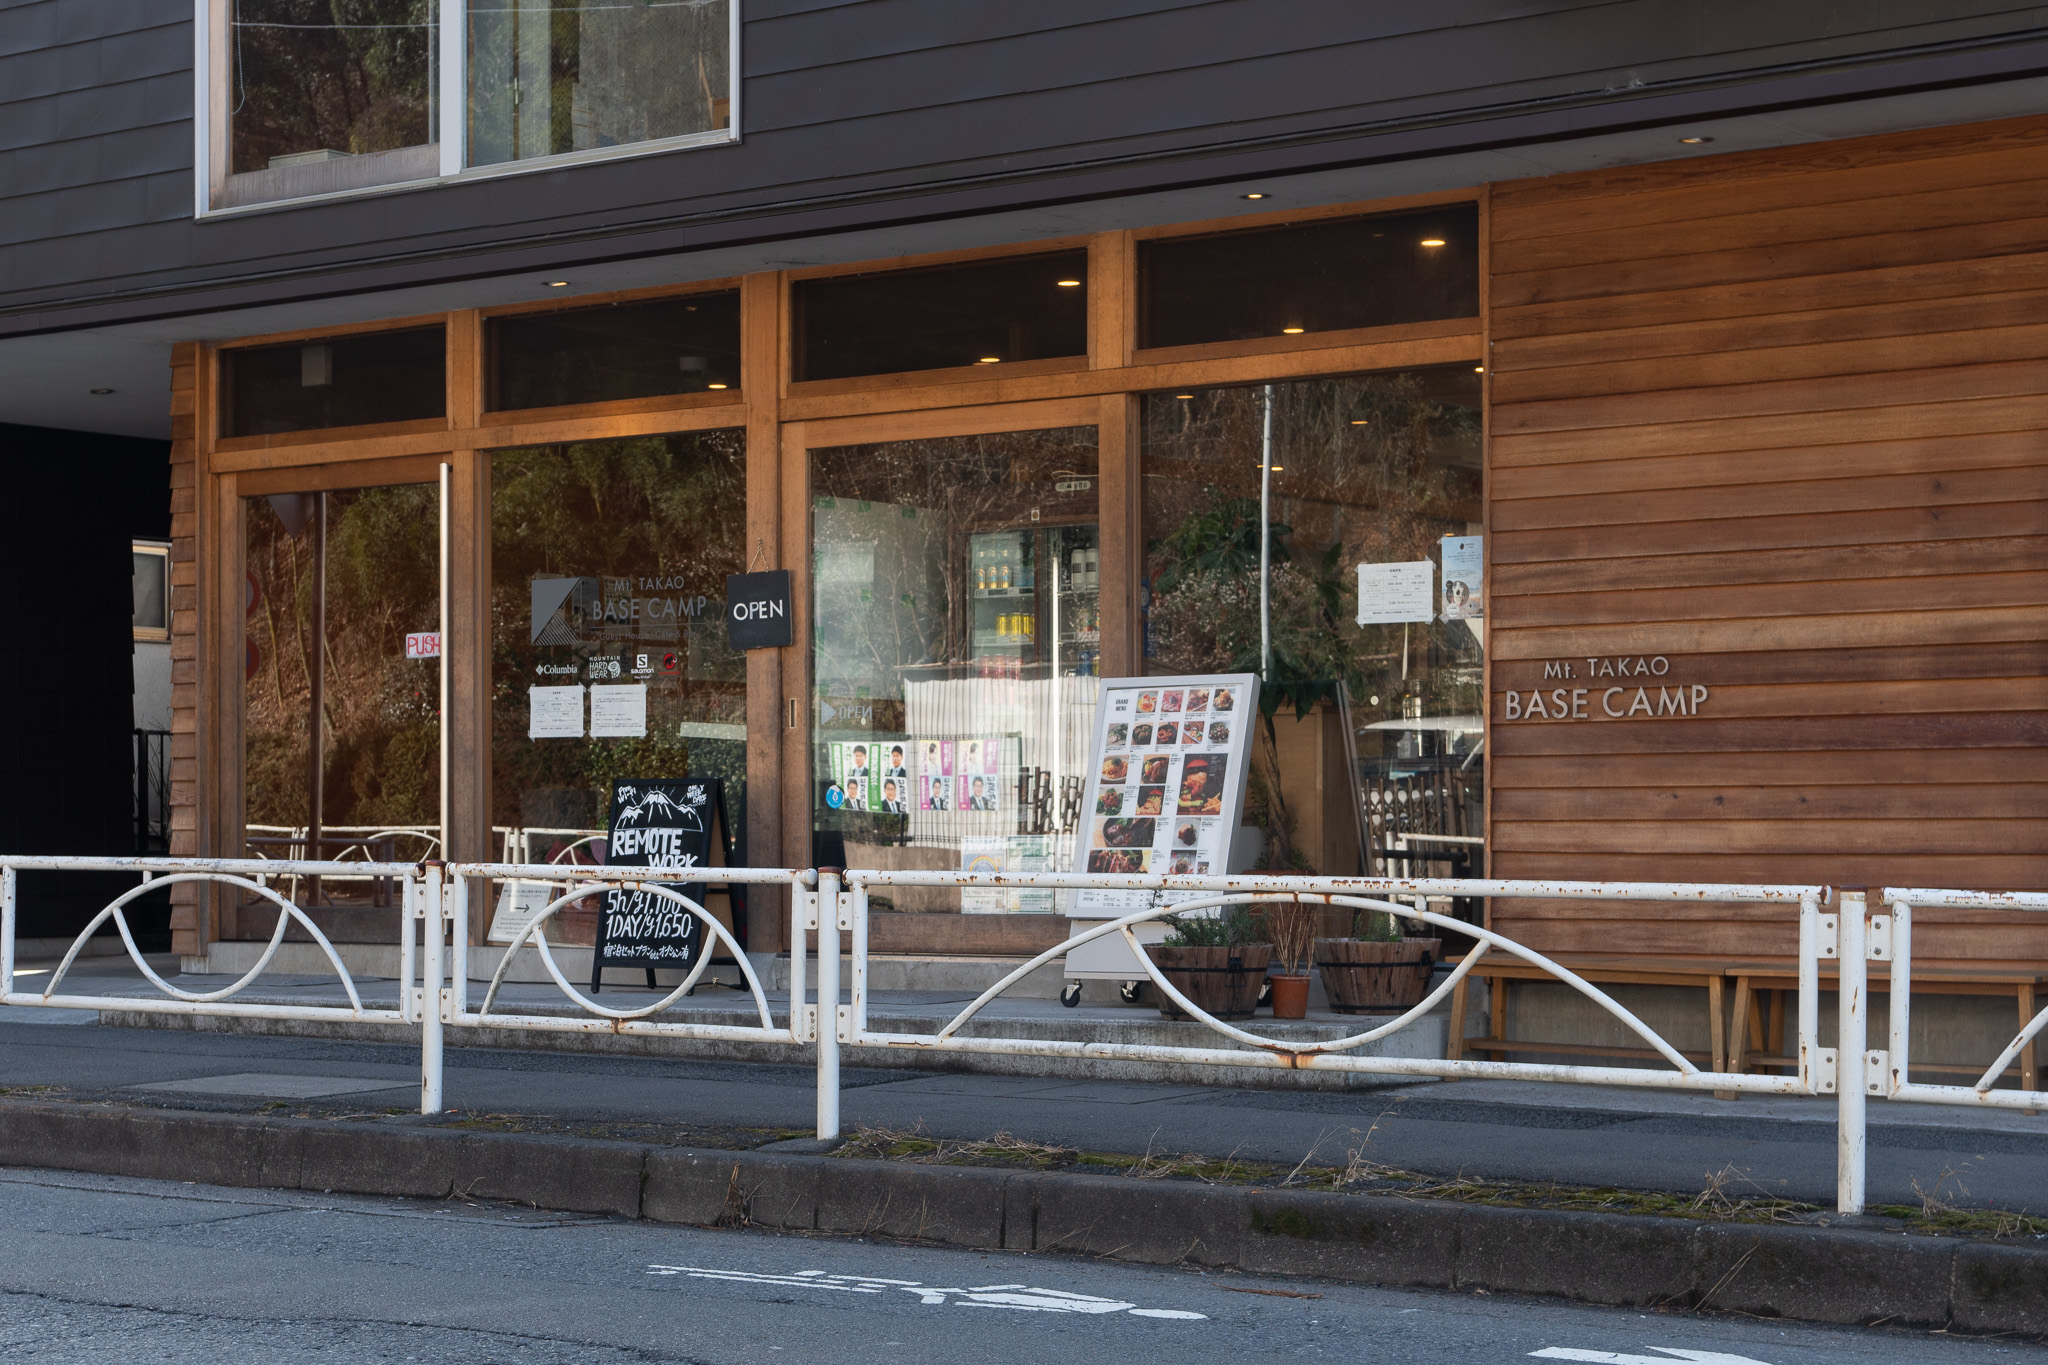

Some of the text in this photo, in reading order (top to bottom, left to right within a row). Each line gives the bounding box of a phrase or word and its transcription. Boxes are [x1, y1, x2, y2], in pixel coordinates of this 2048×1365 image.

[614, 575, 685, 592] Mt. TAKAO
[592, 595, 707, 621] BASE CAMP
[733, 599, 784, 621] OPEN
[407, 635, 440, 655] PUSH
[543, 664, 578, 675] Columbia
[589, 661, 607, 671] HARD
[589, 670, 608, 679] WEAR
[1544, 656, 1669, 679] Mt. TAKAO
[1505, 684, 1708, 720] BASE CAMP
[611, 828, 683, 858] REMOTE
[647, 853, 699, 868] WORK
